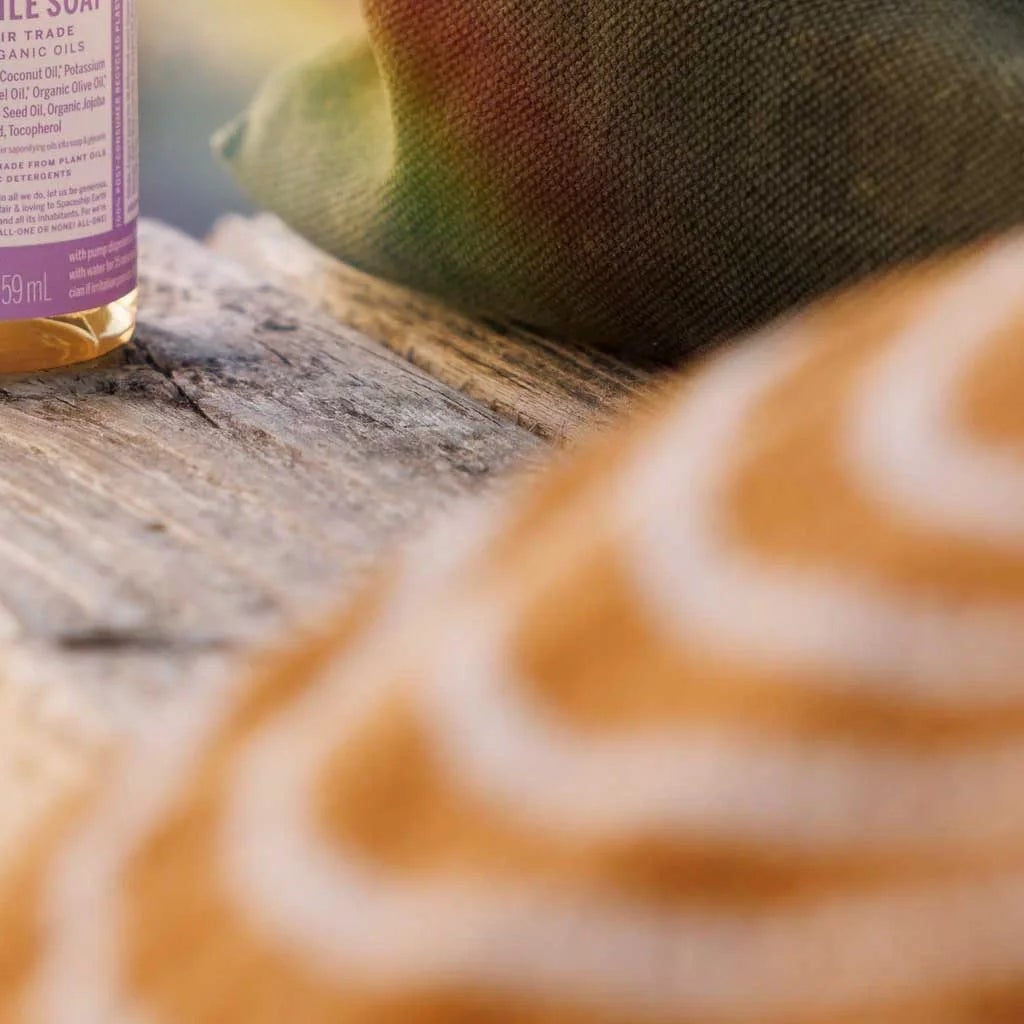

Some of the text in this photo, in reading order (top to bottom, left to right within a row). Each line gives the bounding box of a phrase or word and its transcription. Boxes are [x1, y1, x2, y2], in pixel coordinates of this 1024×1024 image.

[24, 25, 74, 40] TRADE
[53, 41, 85, 56] OILS
[0, 68, 42, 82] Coconut
[64, 60, 106, 76] Potassium
[32, 83, 70, 100] Organic
[72, 80, 92, 93] Olive
[3, 106, 27, 119] Seed
[30, 104, 46, 117] Oil,
[47, 100, 81, 116] Organic
[82, 95, 106, 112] Jojoba
[9, 120, 62, 138] Tocopherol
[28, 159, 55, 169] FROM
[59, 153, 87, 165] PLANT
[6, 169, 72, 183] DETERGENTS
[15, 215, 24, 224] all
[26, 214, 36, 223] its
